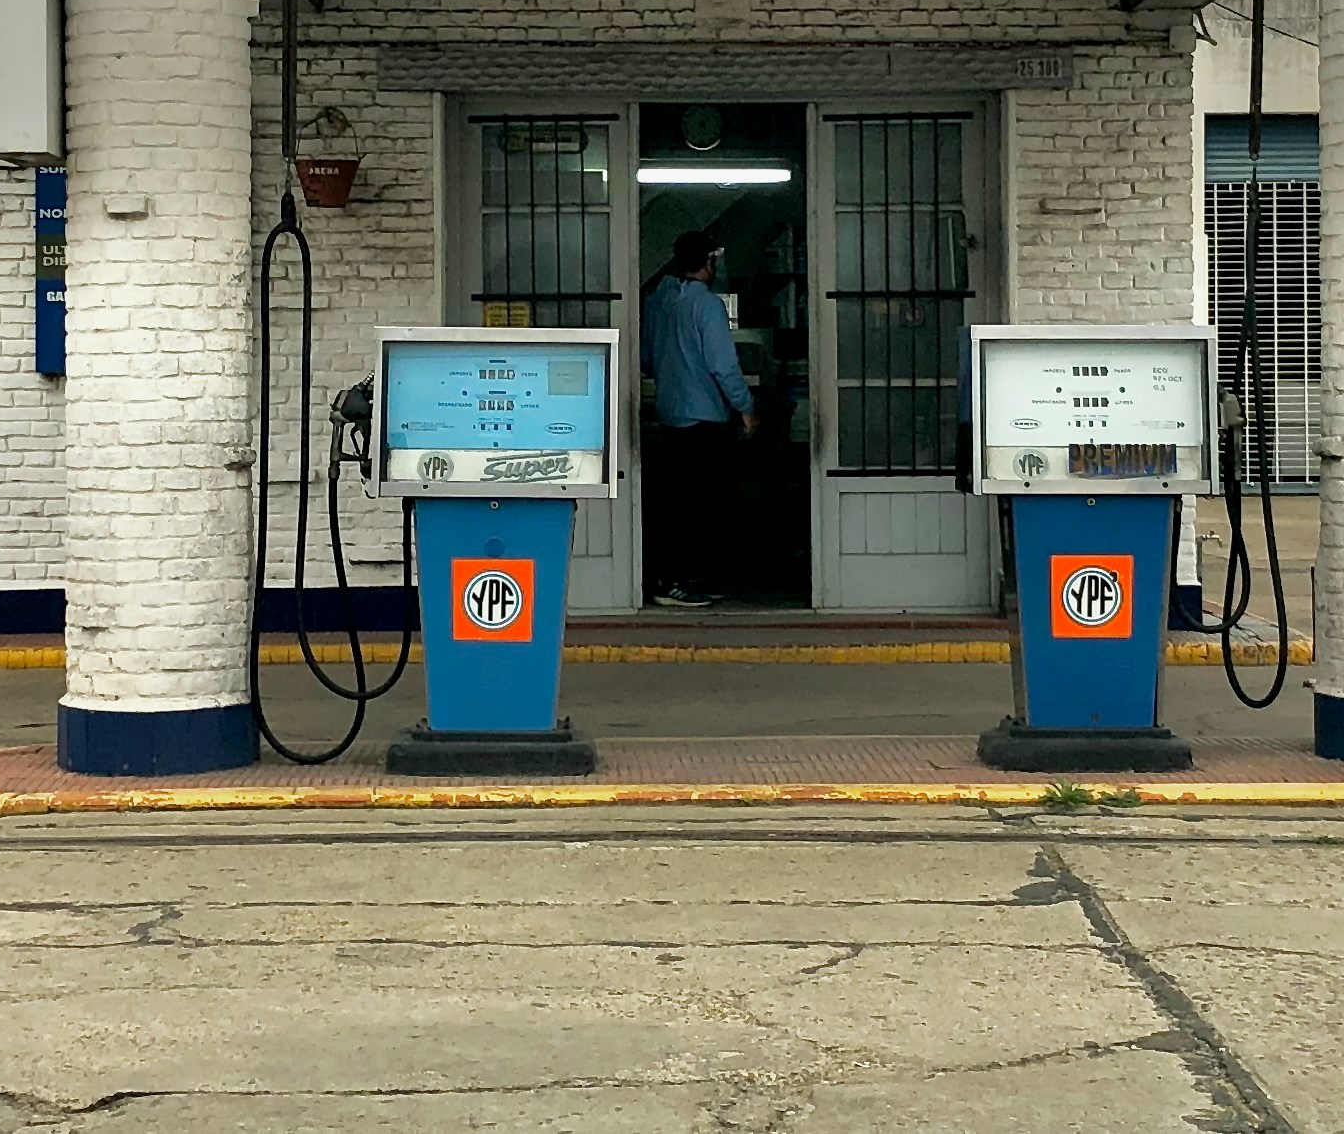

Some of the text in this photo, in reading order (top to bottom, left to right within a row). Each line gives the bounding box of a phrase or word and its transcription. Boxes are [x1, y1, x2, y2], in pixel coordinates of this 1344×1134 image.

[423, 456, 449, 480] YPF
[482, 455, 574, 481] Super
[1019, 453, 1044, 477] YPF
[471, 578, 515, 622] YPF
[1070, 574, 1114, 618] YPF
